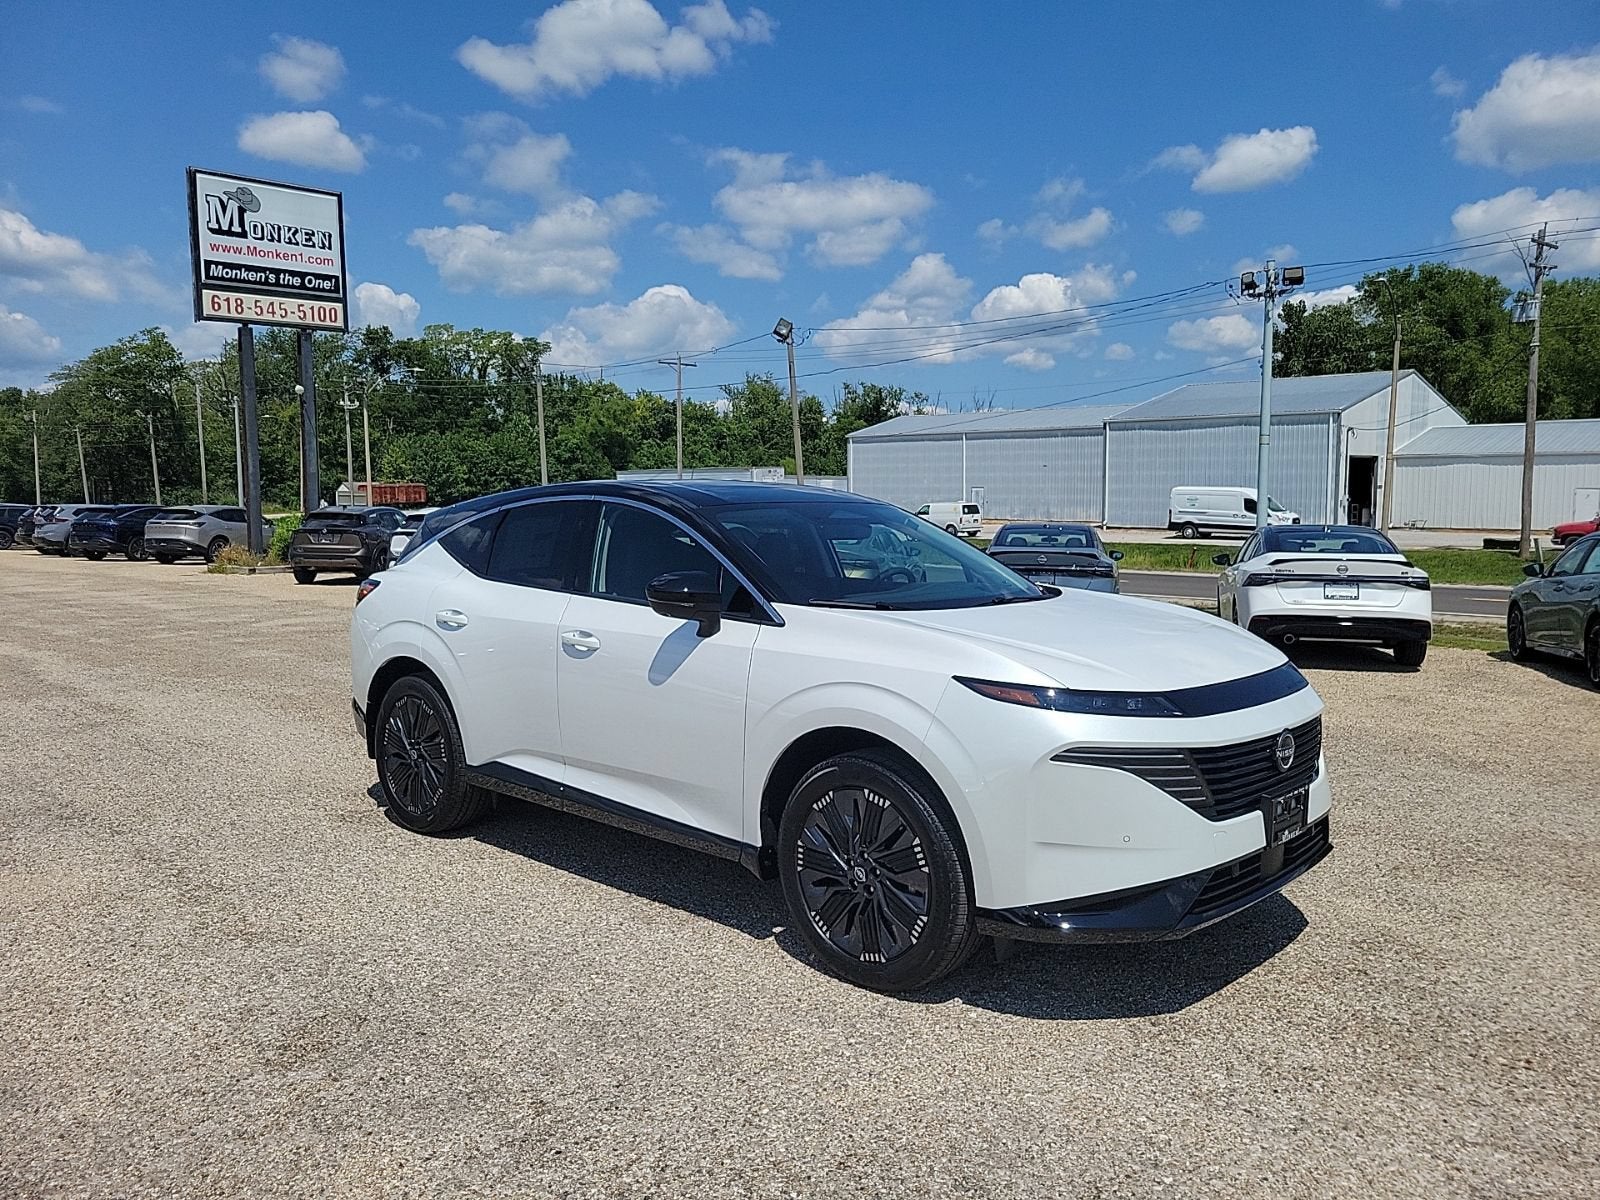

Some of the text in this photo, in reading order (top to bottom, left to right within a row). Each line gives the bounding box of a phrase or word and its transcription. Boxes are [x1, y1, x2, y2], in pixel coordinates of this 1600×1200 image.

[209, 242, 334, 267] www.Monken1.com
[210, 264, 336, 290] Monken's the One!
[210, 294, 338, 323] 618-545-5100
